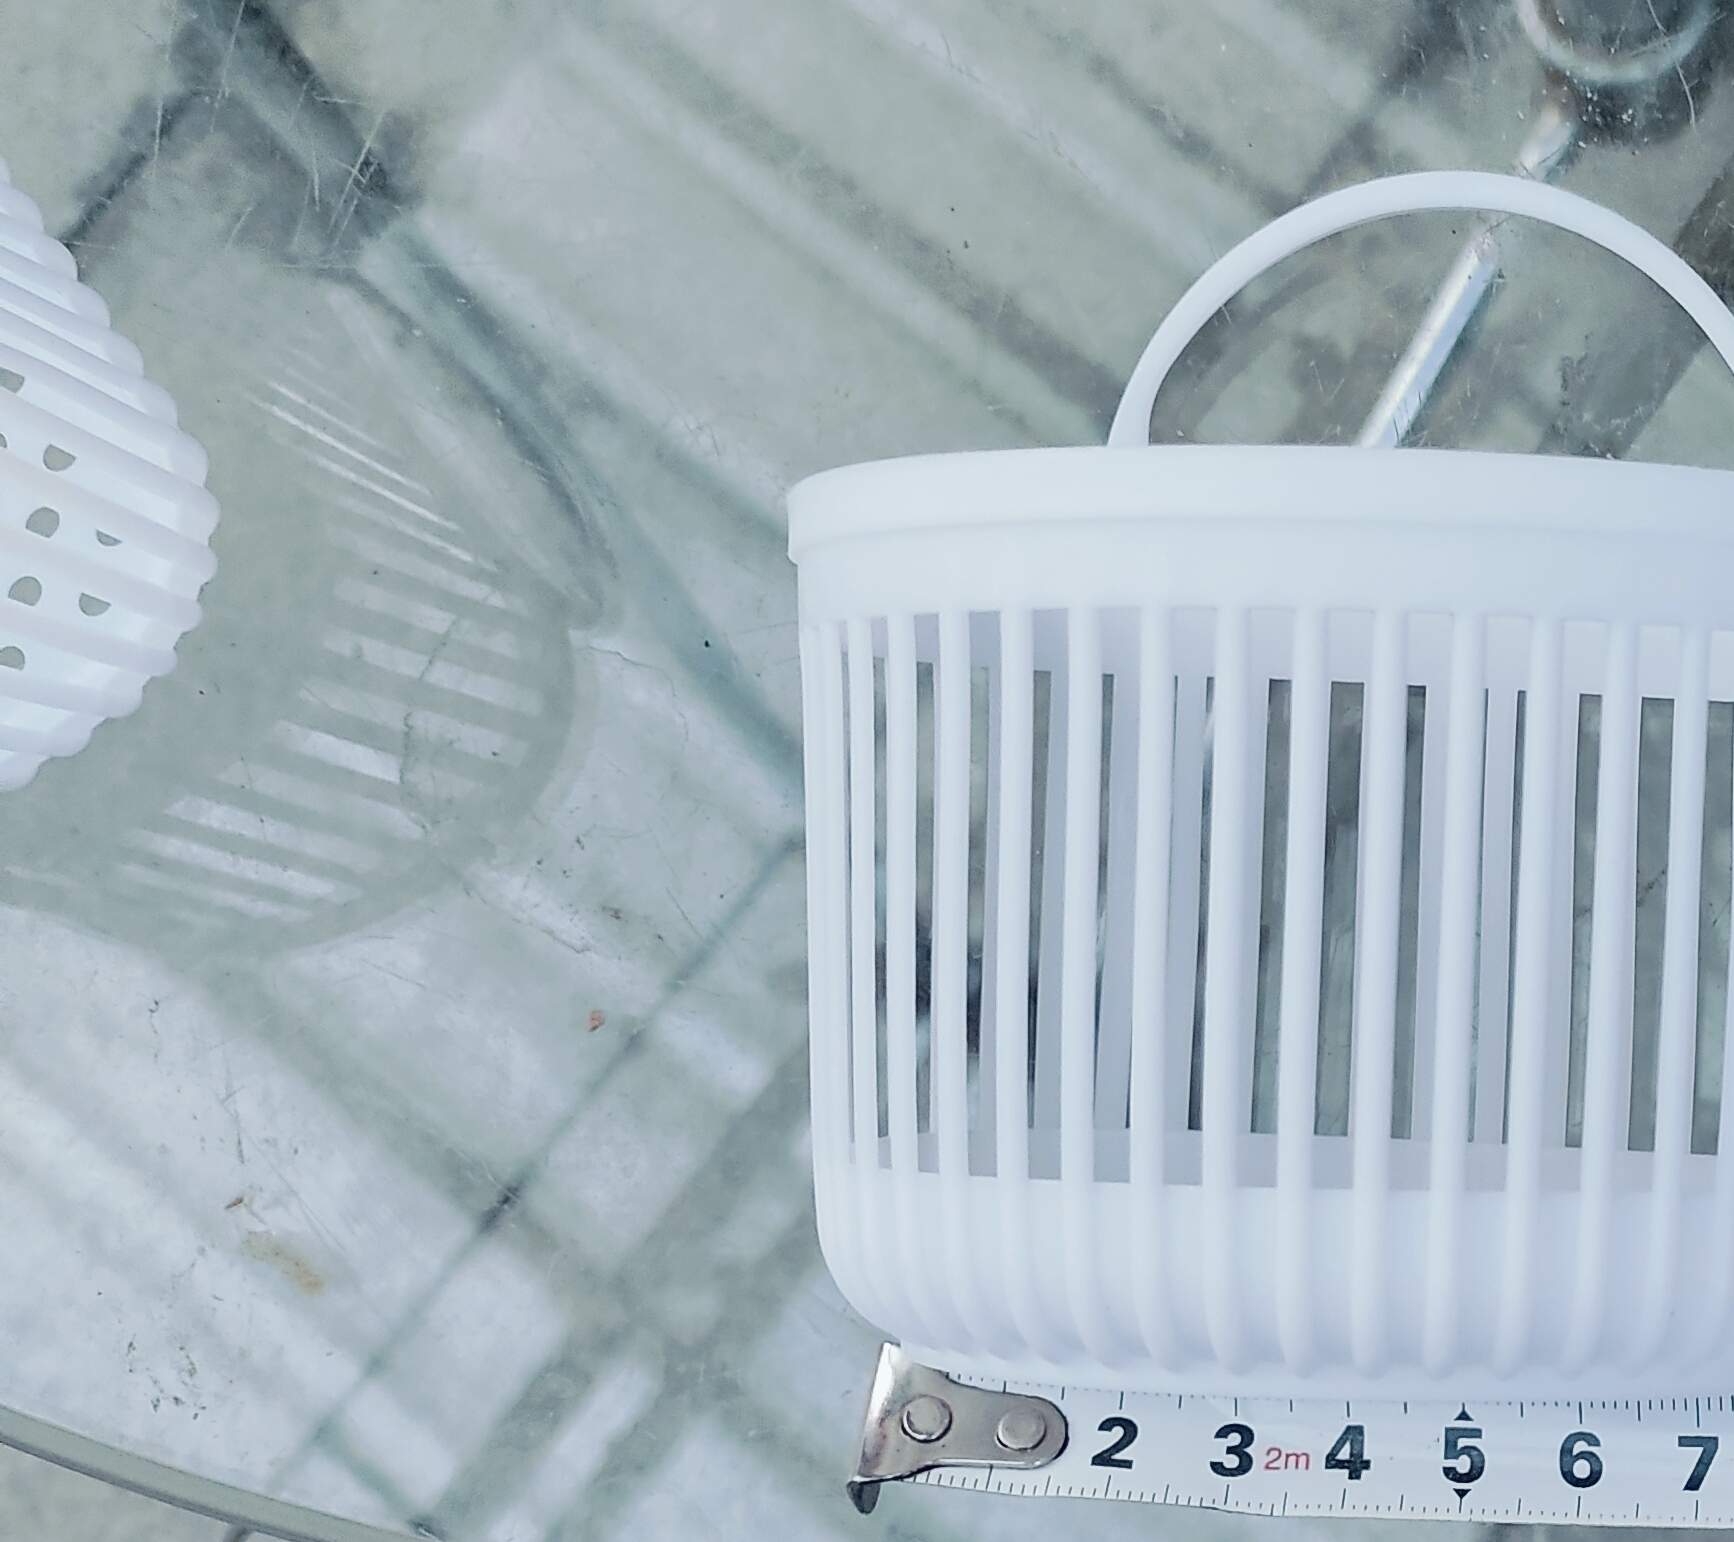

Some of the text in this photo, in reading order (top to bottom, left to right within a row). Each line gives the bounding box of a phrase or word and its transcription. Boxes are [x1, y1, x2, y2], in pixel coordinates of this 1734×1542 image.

[1090, 1416, 1139, 1470] 2
[1209, 1423, 1255, 1478] 3
[1263, 1444, 1312, 1472] 2m
[1324, 1424, 1372, 1481] 4
[1442, 1426, 1486, 1484] 5
[1559, 1431, 1604, 1489] 6
[1677, 1435, 1719, 1492] 7
